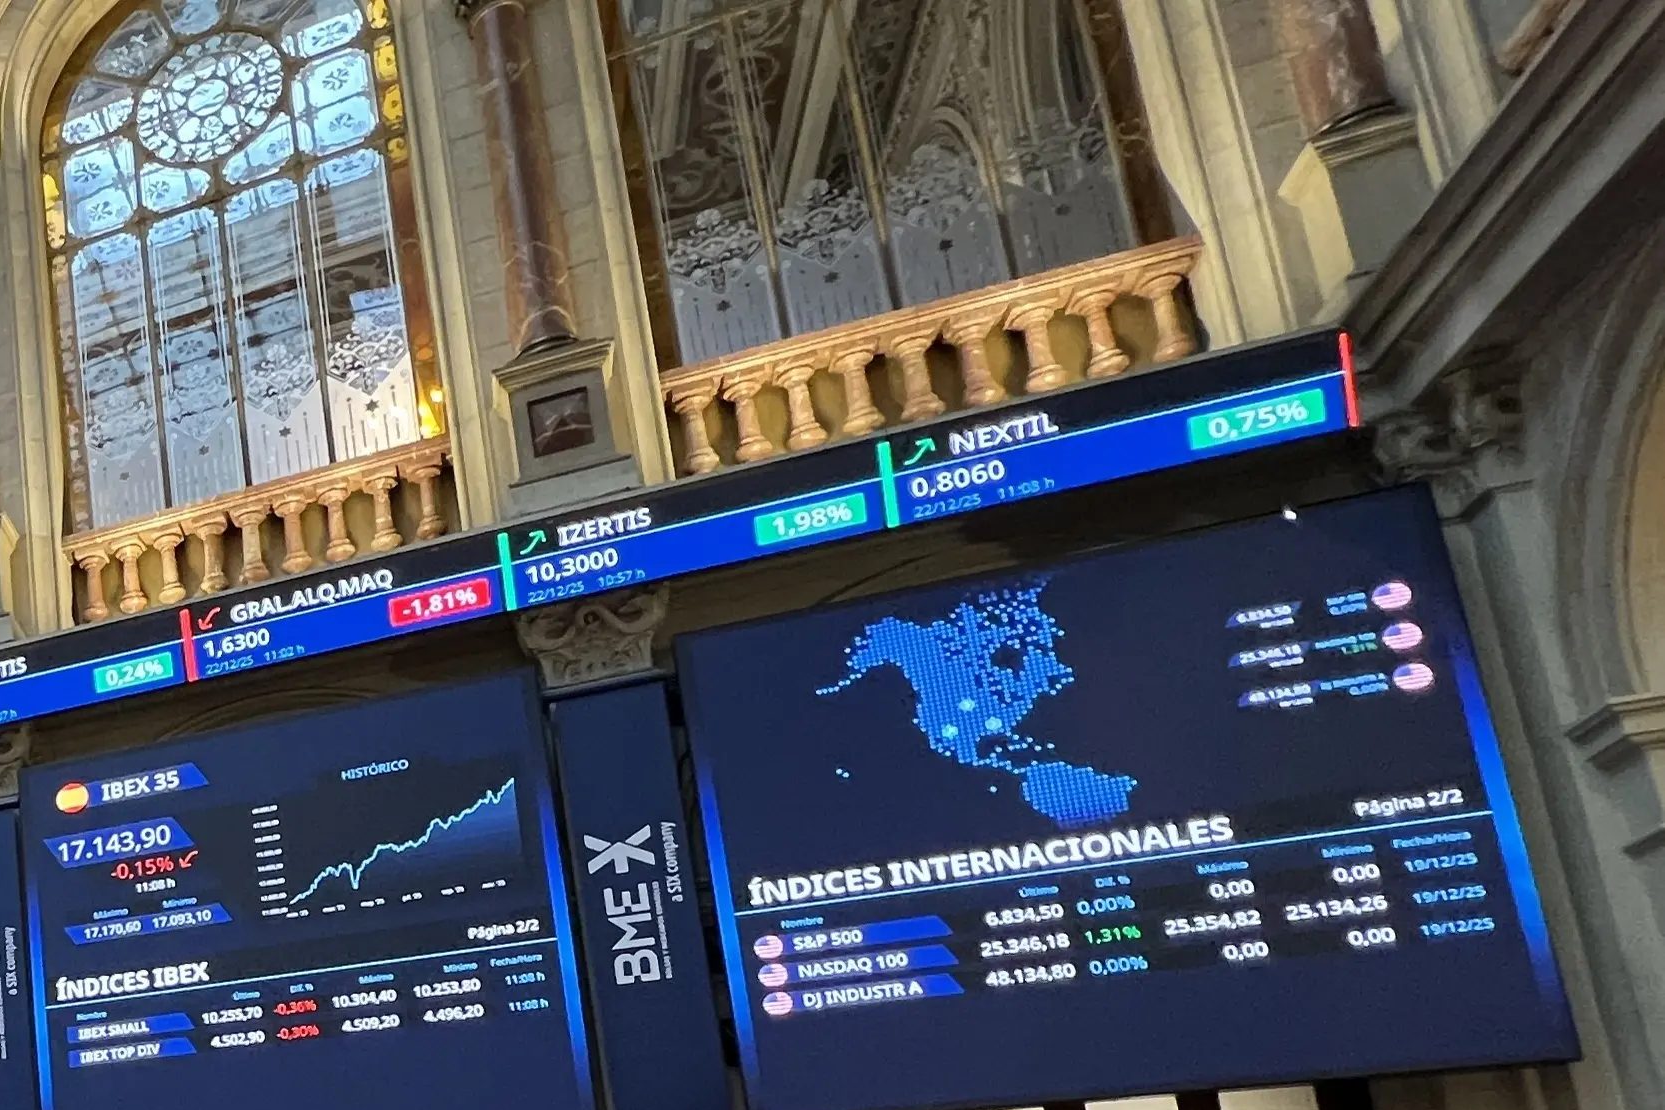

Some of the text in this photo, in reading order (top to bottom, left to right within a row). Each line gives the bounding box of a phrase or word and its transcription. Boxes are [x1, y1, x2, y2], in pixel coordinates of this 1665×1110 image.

[949, 412, 1059, 456] NEXTIL
[1207, 398, 1308, 440] 0,75%
[910, 458, 1005, 498] 0,8060
[773, 502, 853, 537] 1,98%
[913, 492, 981, 520] 22/12/25
[557, 506, 651, 546] IZERTIS
[525, 548, 618, 584] 10,3000
[229, 568, 394, 624] GRAL.ALQ.MAQ
[403, 587, 477, 617] -1,81%
[527, 580, 584, 603] 22/12/25
[203, 628, 270, 659] 1,6300
[105, 658, 163, 687] 0,24%
[205, 655, 254, 675] 22/12/25
[101, 770, 179, 802] IBEX 35
[341, 759, 409, 780] HISTÓRICO
[1354, 788, 1464, 819] Página 2/2
[59, 825, 171, 862] 17.143,90
[747, 815, 1234, 906] ÍNDICES INTERNACIONALES
[110, 856, 174, 879] -0,15%
[661, 822, 683, 903] a SIX company
[780, 914, 824, 929] Nombre
[1321, 844, 1374, 858] Mínimo
[1392, 831, 1471, 848] Fecha/Hora
[167, 878, 175, 888] h
[793, 853, 1478, 950] S&P 500 6.834,50 0,00% 0,00 0,00 19/12/25
[84, 910, 211, 939] 17.170,60 17.093,10
[467, 919, 539, 941] Página 2/2
[603, 882, 660, 985] BME
[797, 885, 1487, 979] NASDAQ 100 25.346,18 1,31% 25.354,82 25.134,26 19/12/25
[56, 961, 210, 1001] ÍNDICES IBEX
[803, 917, 1495, 1009] DJ INDUSTR A 48.134,80 0,00% 0,00 0,00 19/12/25
[78, 1025, 107, 1039] IBEX
[108, 1021, 150, 1037] SMALL
[331, 989, 397, 1009] 10.304,40
[413, 978, 481, 997] 10.253,80
[79, 1048, 109, 1064] IBEX
[111, 1046, 136, 1060] TOP
[137, 1044, 160, 1057] DIV
[341, 1014, 400, 1033] 4.509,20
[423, 1003, 485, 1023] 4.496,20
